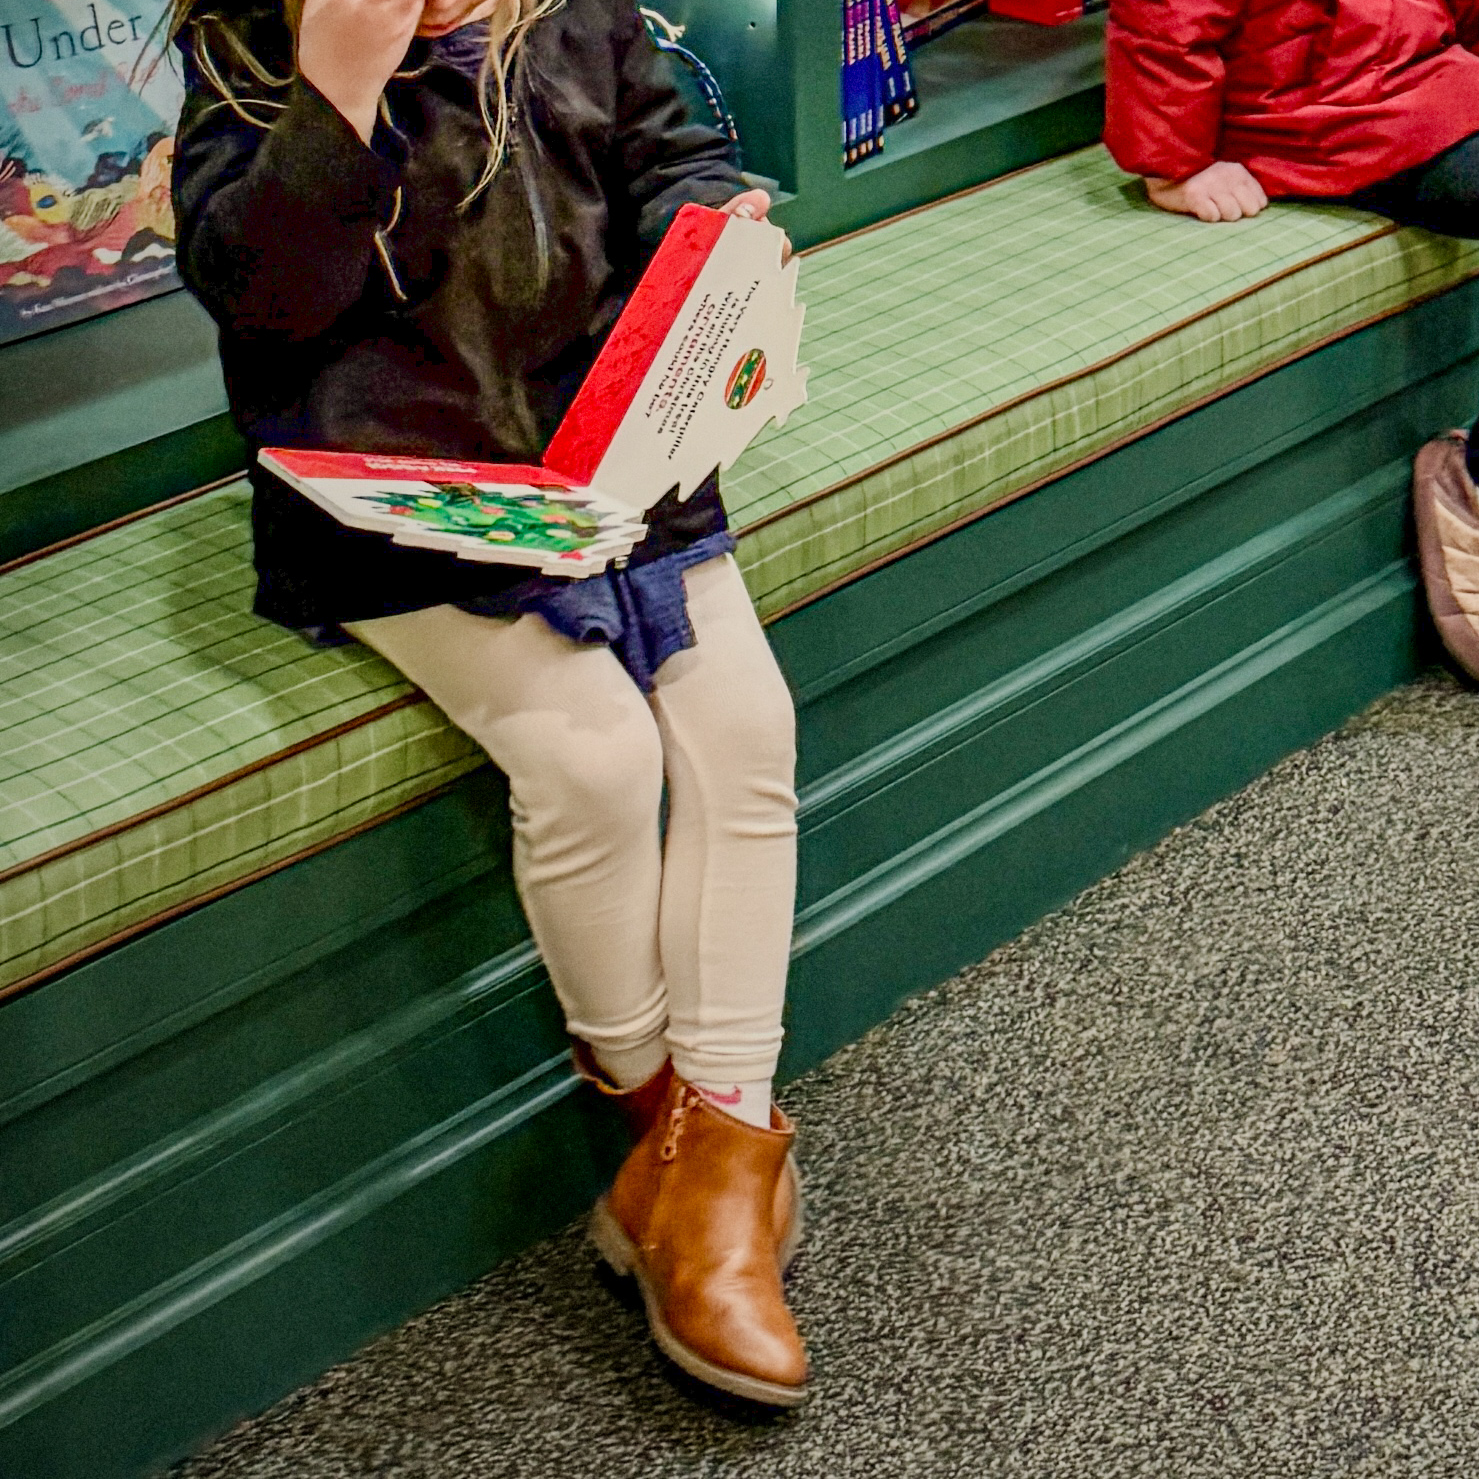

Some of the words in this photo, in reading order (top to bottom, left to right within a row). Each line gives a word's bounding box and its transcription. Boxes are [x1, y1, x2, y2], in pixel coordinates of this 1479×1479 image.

[1, 3, 142, 69] Under
[728, 306, 746, 332] Very
[702, 339, 729, 385] Hungry
